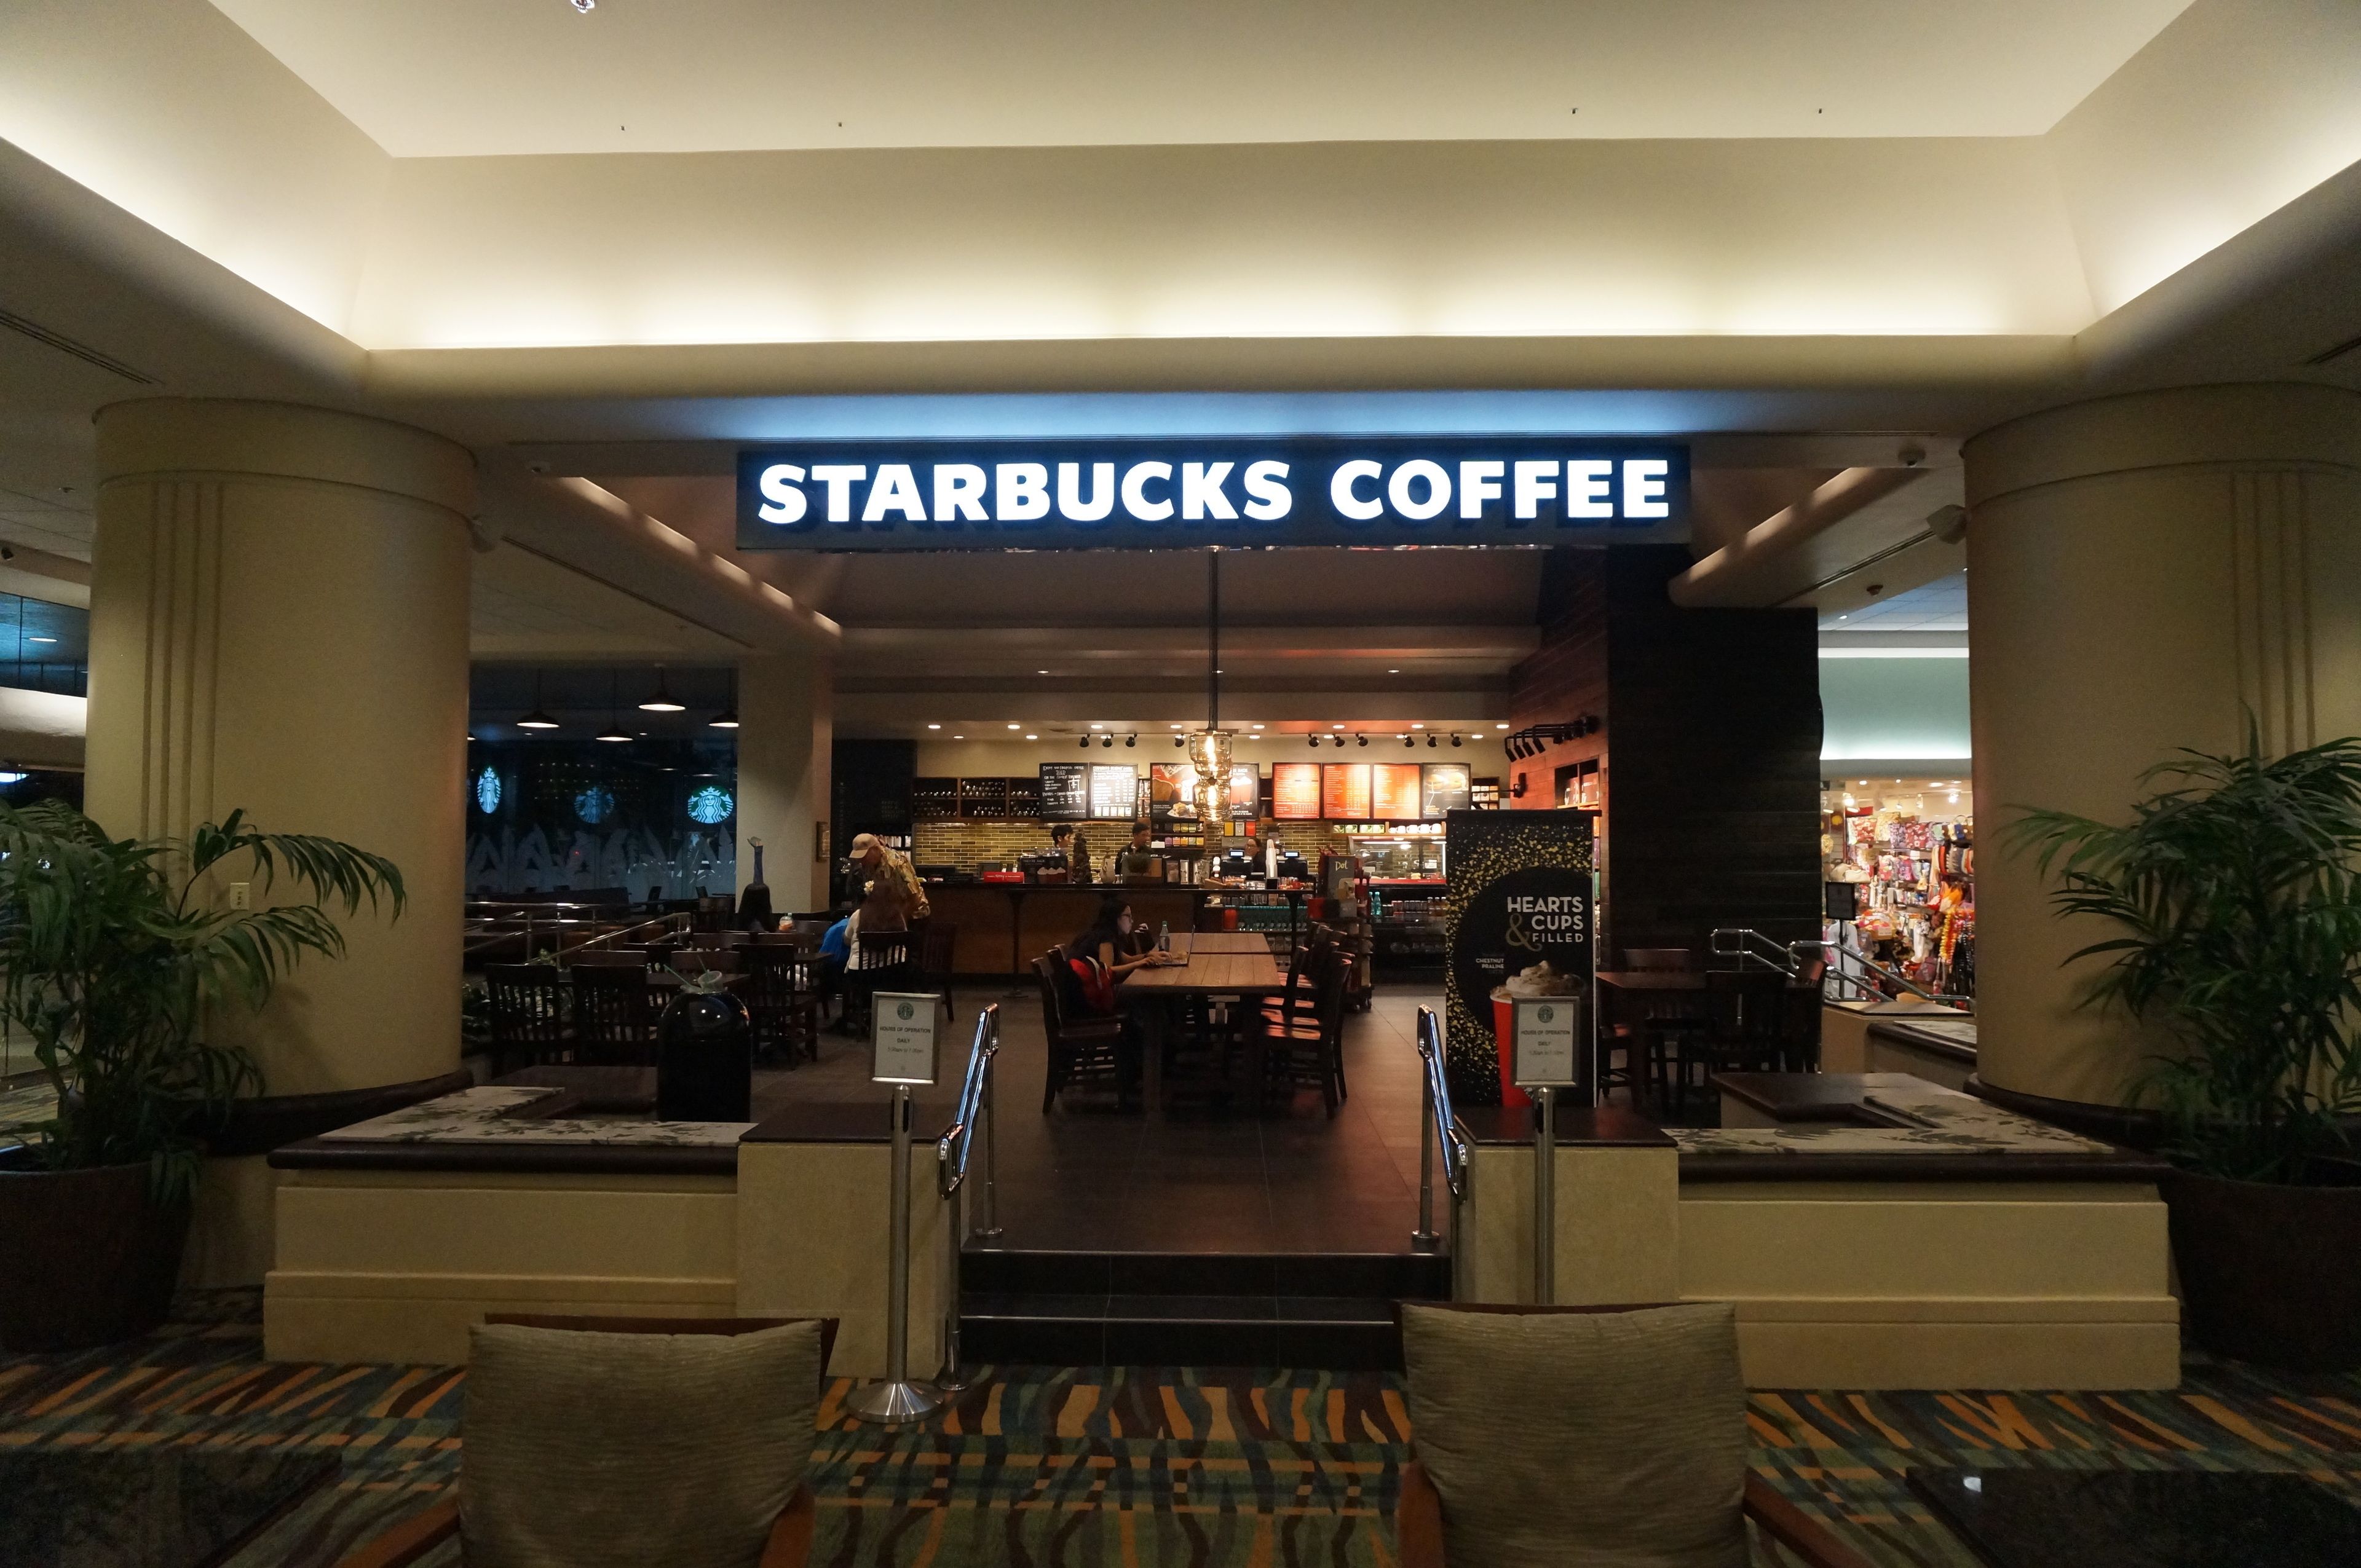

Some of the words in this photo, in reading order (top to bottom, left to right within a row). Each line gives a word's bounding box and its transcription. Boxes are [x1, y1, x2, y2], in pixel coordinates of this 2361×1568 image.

[759, 461, 1291, 523] STARBUCKS
[1331, 460, 1668, 519] COFFEE
[1507, 896, 1583, 913] HEARTS
[1531, 915, 1584, 930] CUPS
[1532, 933, 1584, 942] FILLED
